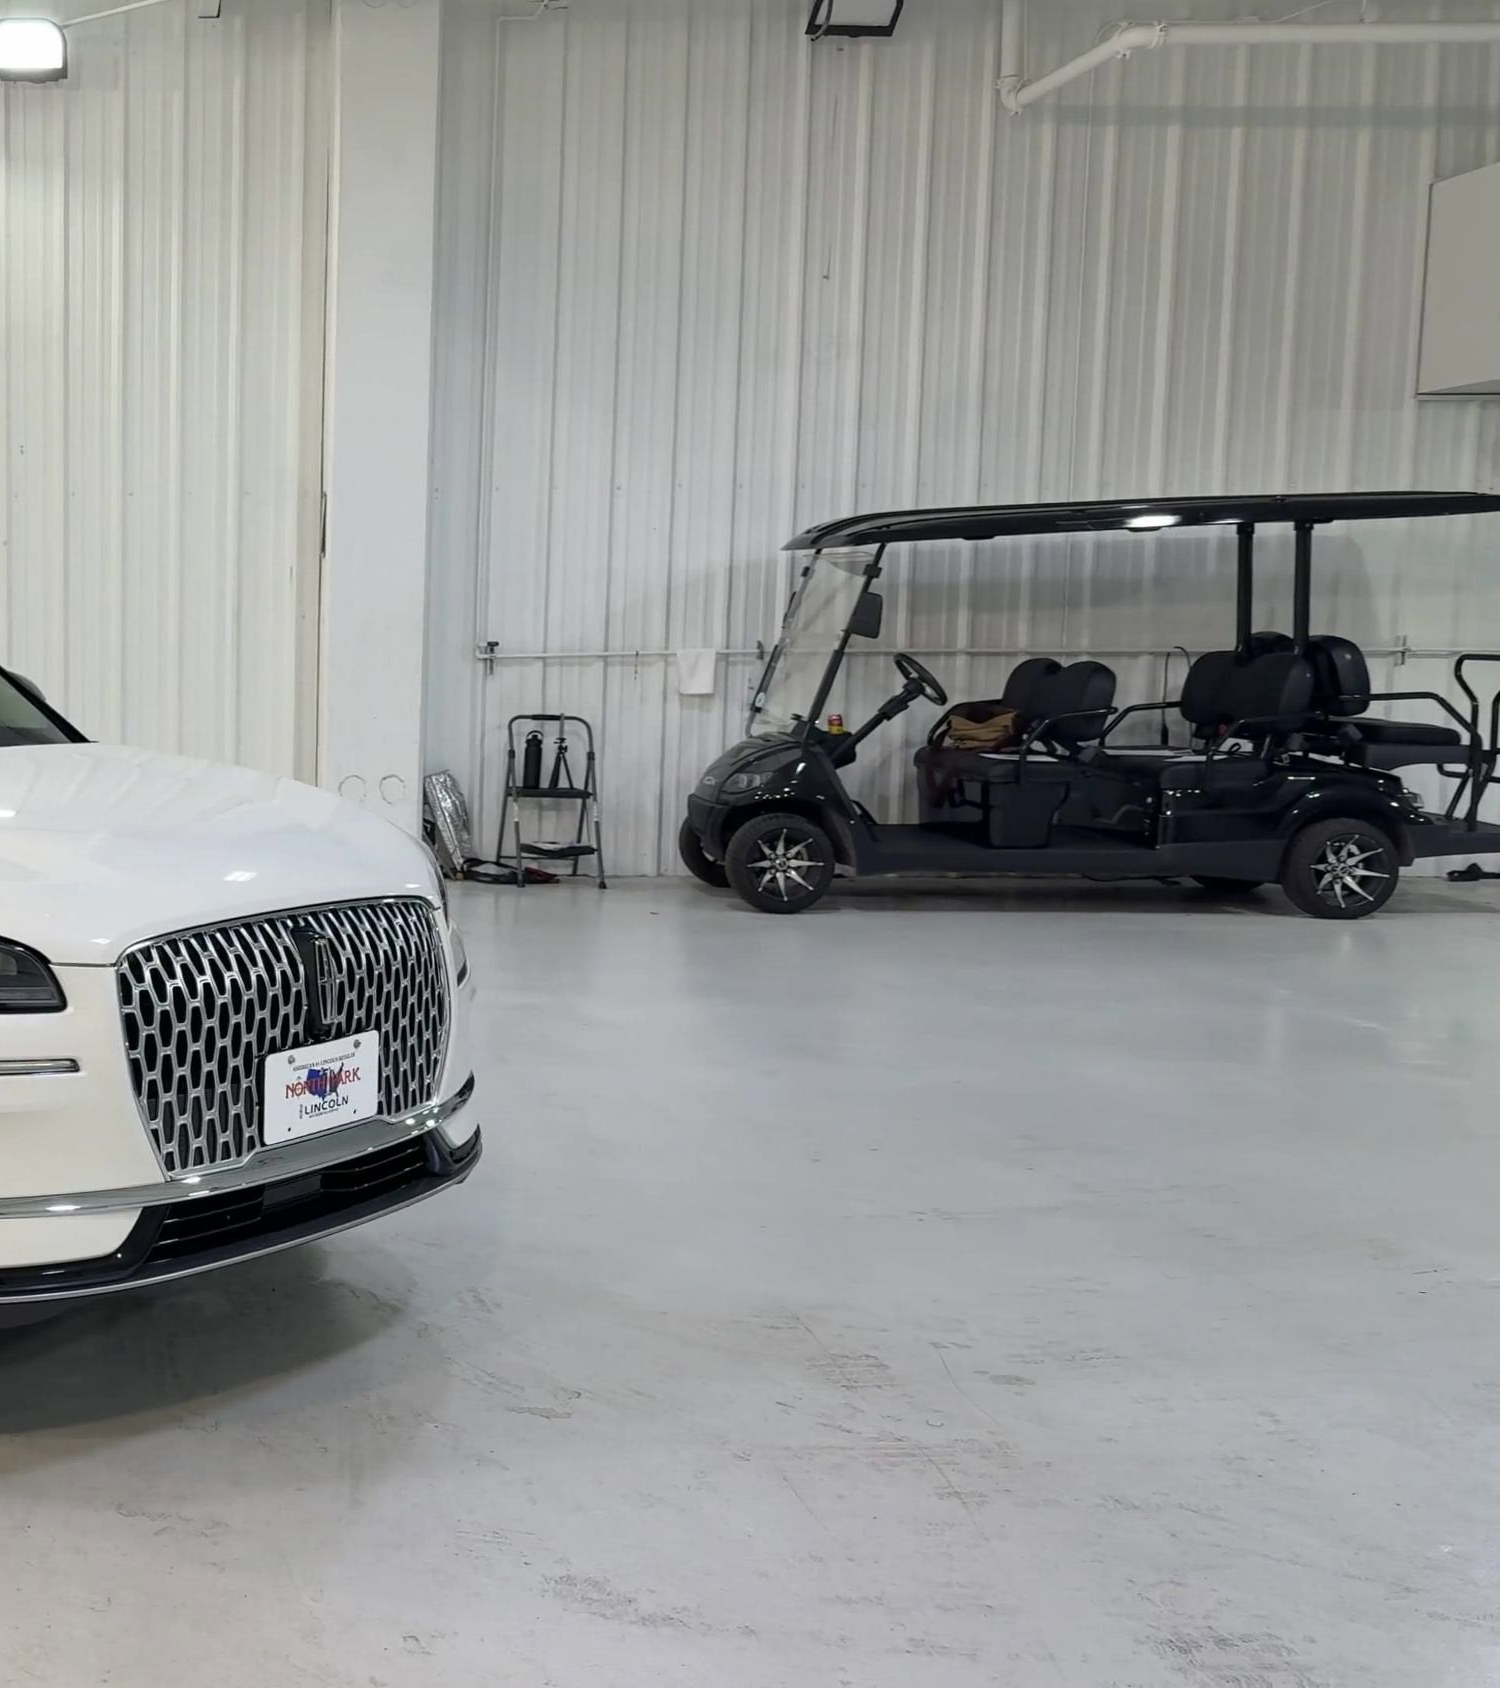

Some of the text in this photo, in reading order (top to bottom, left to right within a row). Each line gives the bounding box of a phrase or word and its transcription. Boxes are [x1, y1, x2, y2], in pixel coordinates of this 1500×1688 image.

[285, 1067, 361, 1099] NORTH PARK
[304, 1095, 349, 1115] LINCOLN
